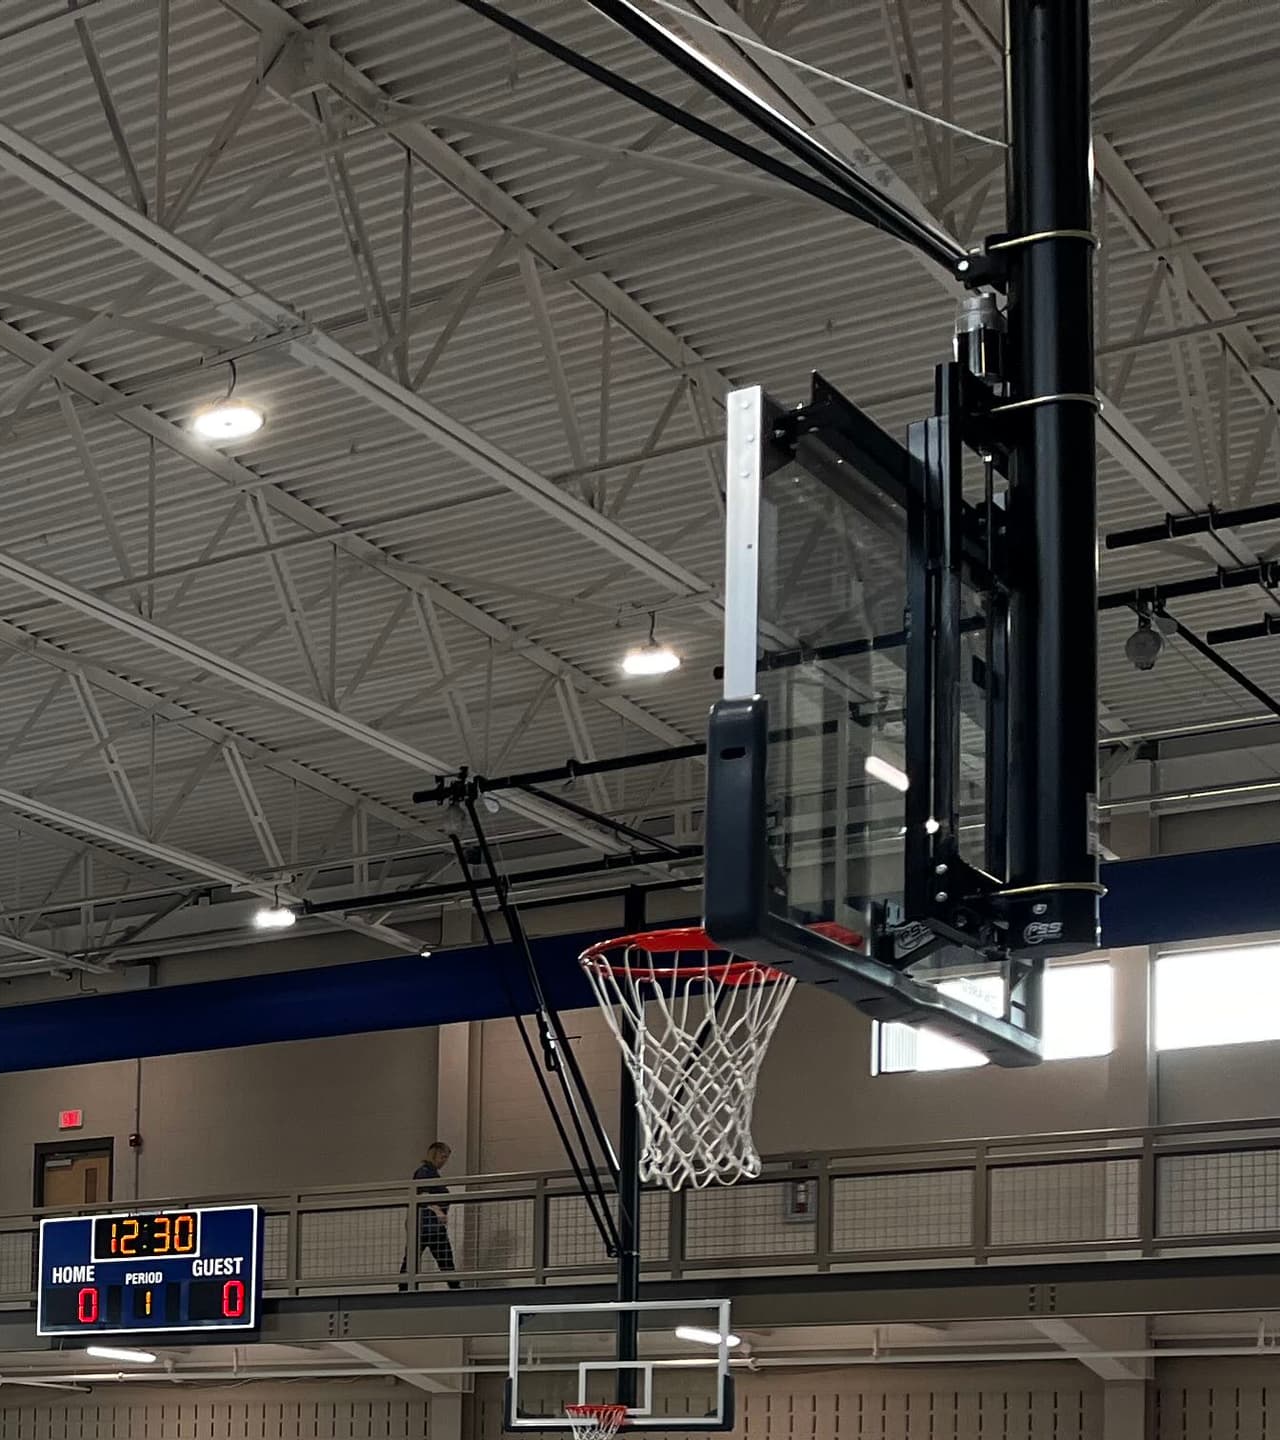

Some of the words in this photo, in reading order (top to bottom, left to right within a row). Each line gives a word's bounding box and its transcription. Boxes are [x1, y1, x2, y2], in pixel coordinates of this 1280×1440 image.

[110, 1215, 194, 1255] 12:30
[52, 1265, 96, 1284] HOME
[125, 1271, 163, 1285] PERIOD
[192, 1257, 244, 1277] GUEST
[77, 1287, 99, 1324] 0
[145, 1290, 152, 1316] 1
[221, 1280, 245, 1318] 0
